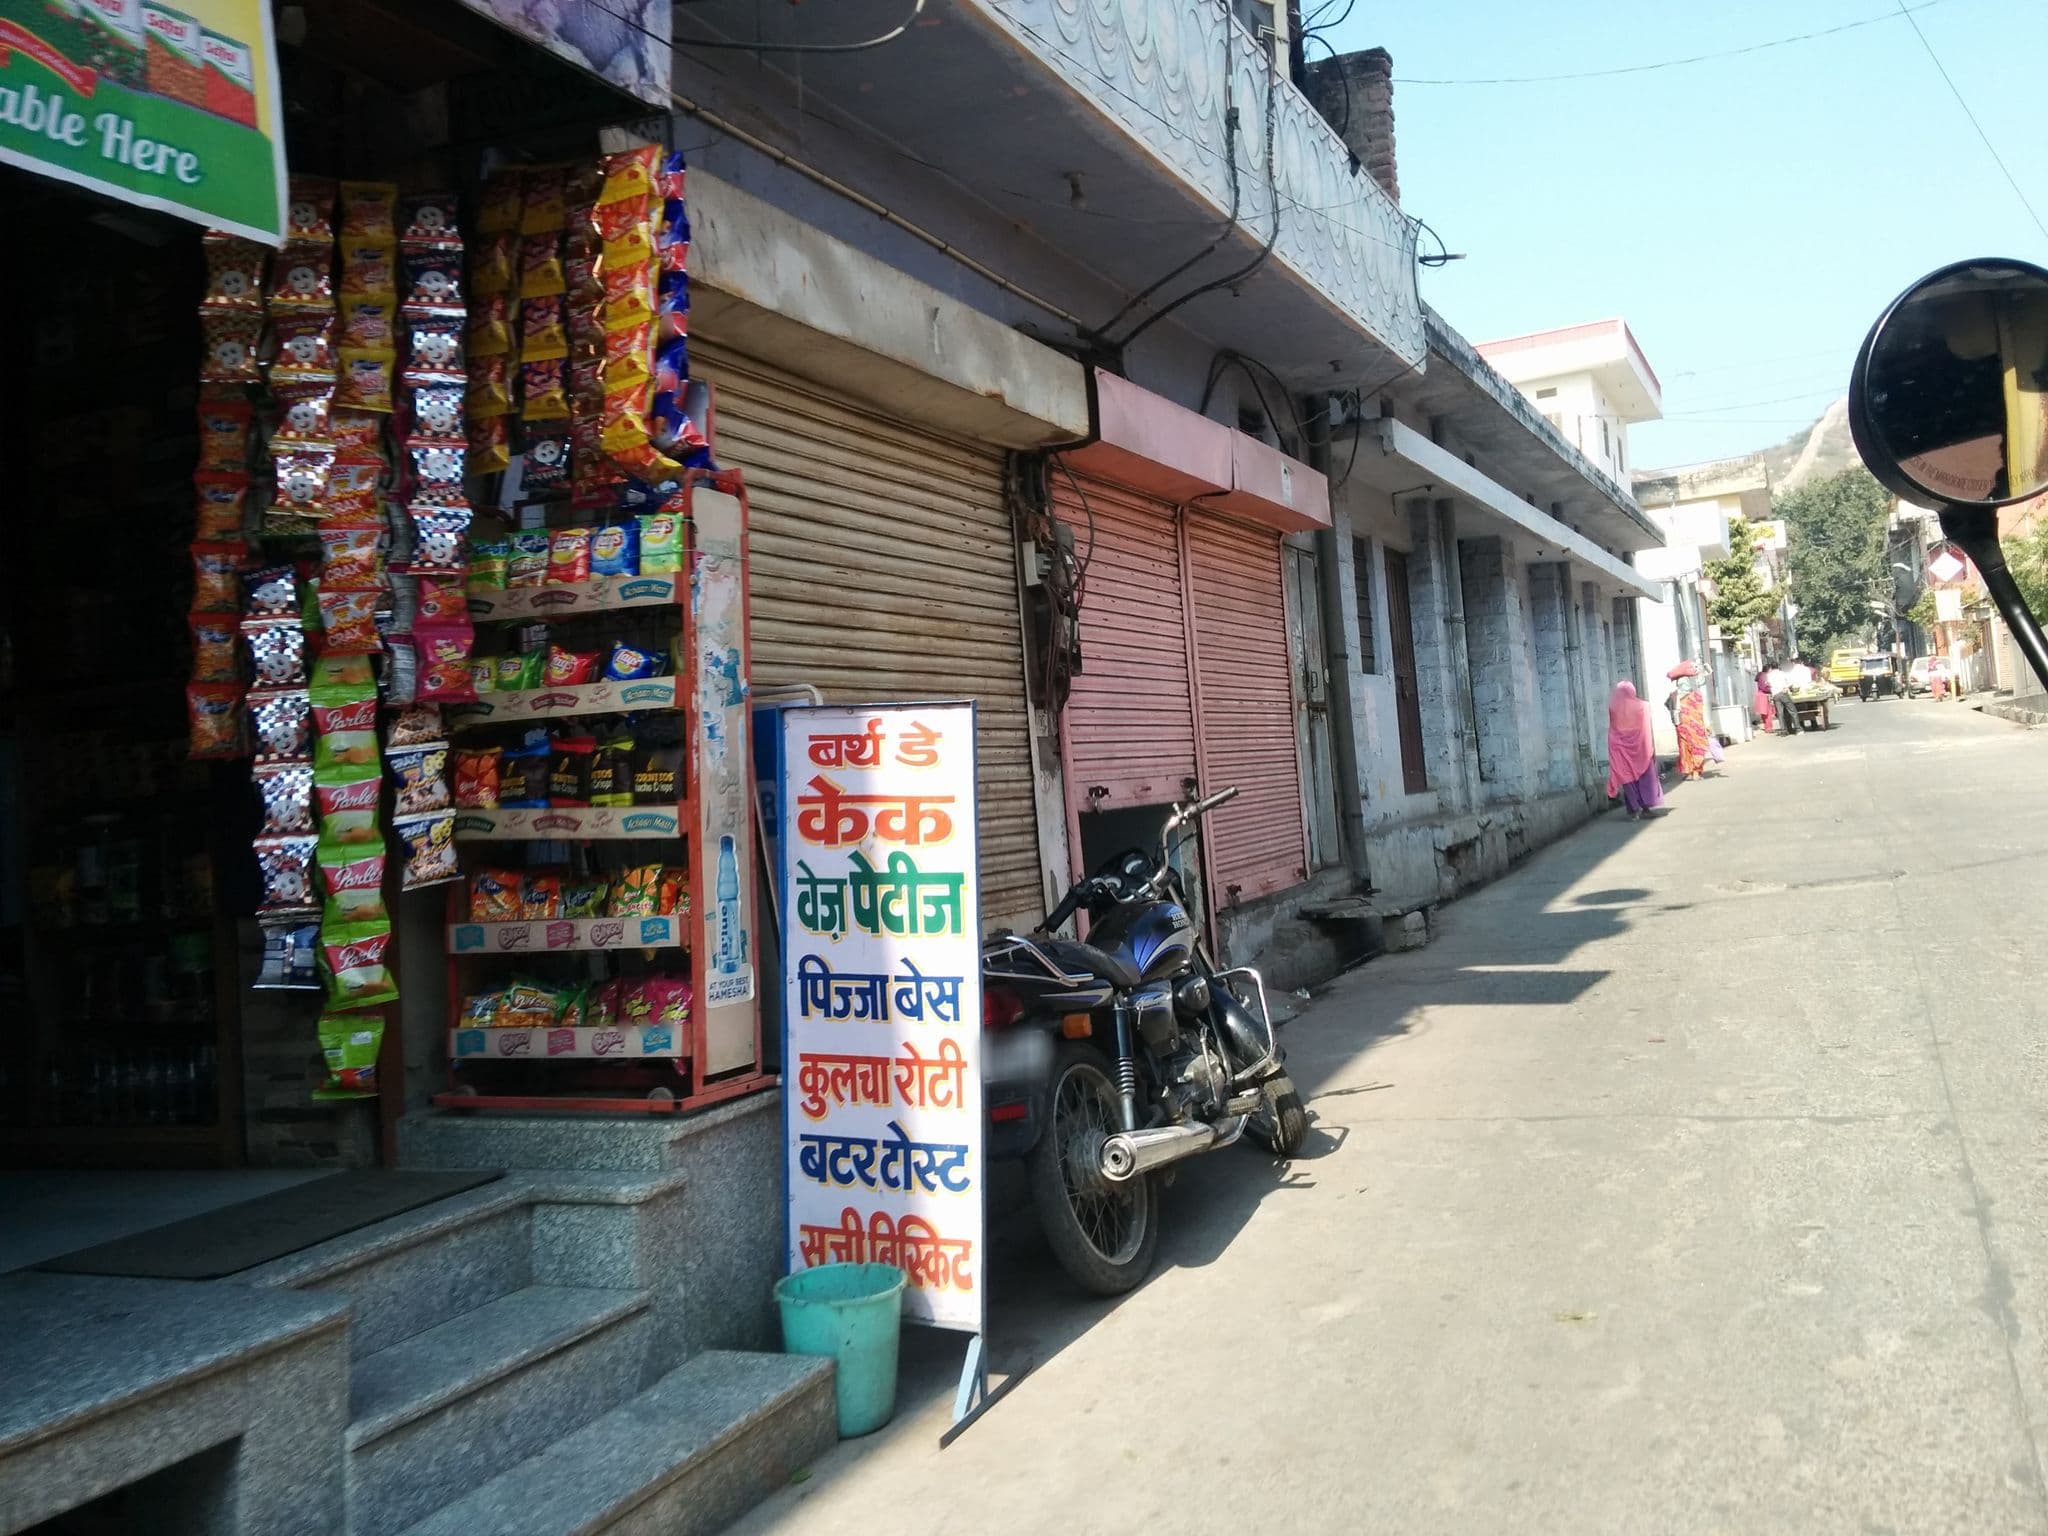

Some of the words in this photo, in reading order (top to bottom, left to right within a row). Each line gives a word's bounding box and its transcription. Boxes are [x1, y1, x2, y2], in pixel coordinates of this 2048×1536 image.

[94, 112, 202, 184] Here
[326, 706, 376, 731] Parle's
[808, 718, 885, 768] बर्थ
[895, 720, 944, 768] डे
[797, 774, 956, 846] केक
[847, 850, 965, 935] पेटीज
[894, 956, 964, 1022] बेस
[799, 1052, 890, 1118] कुलचा
[893, 1038, 968, 1109] रोटी
[800, 1133, 878, 1187] बटर
[880, 1120, 971, 1192] टोस्ट
